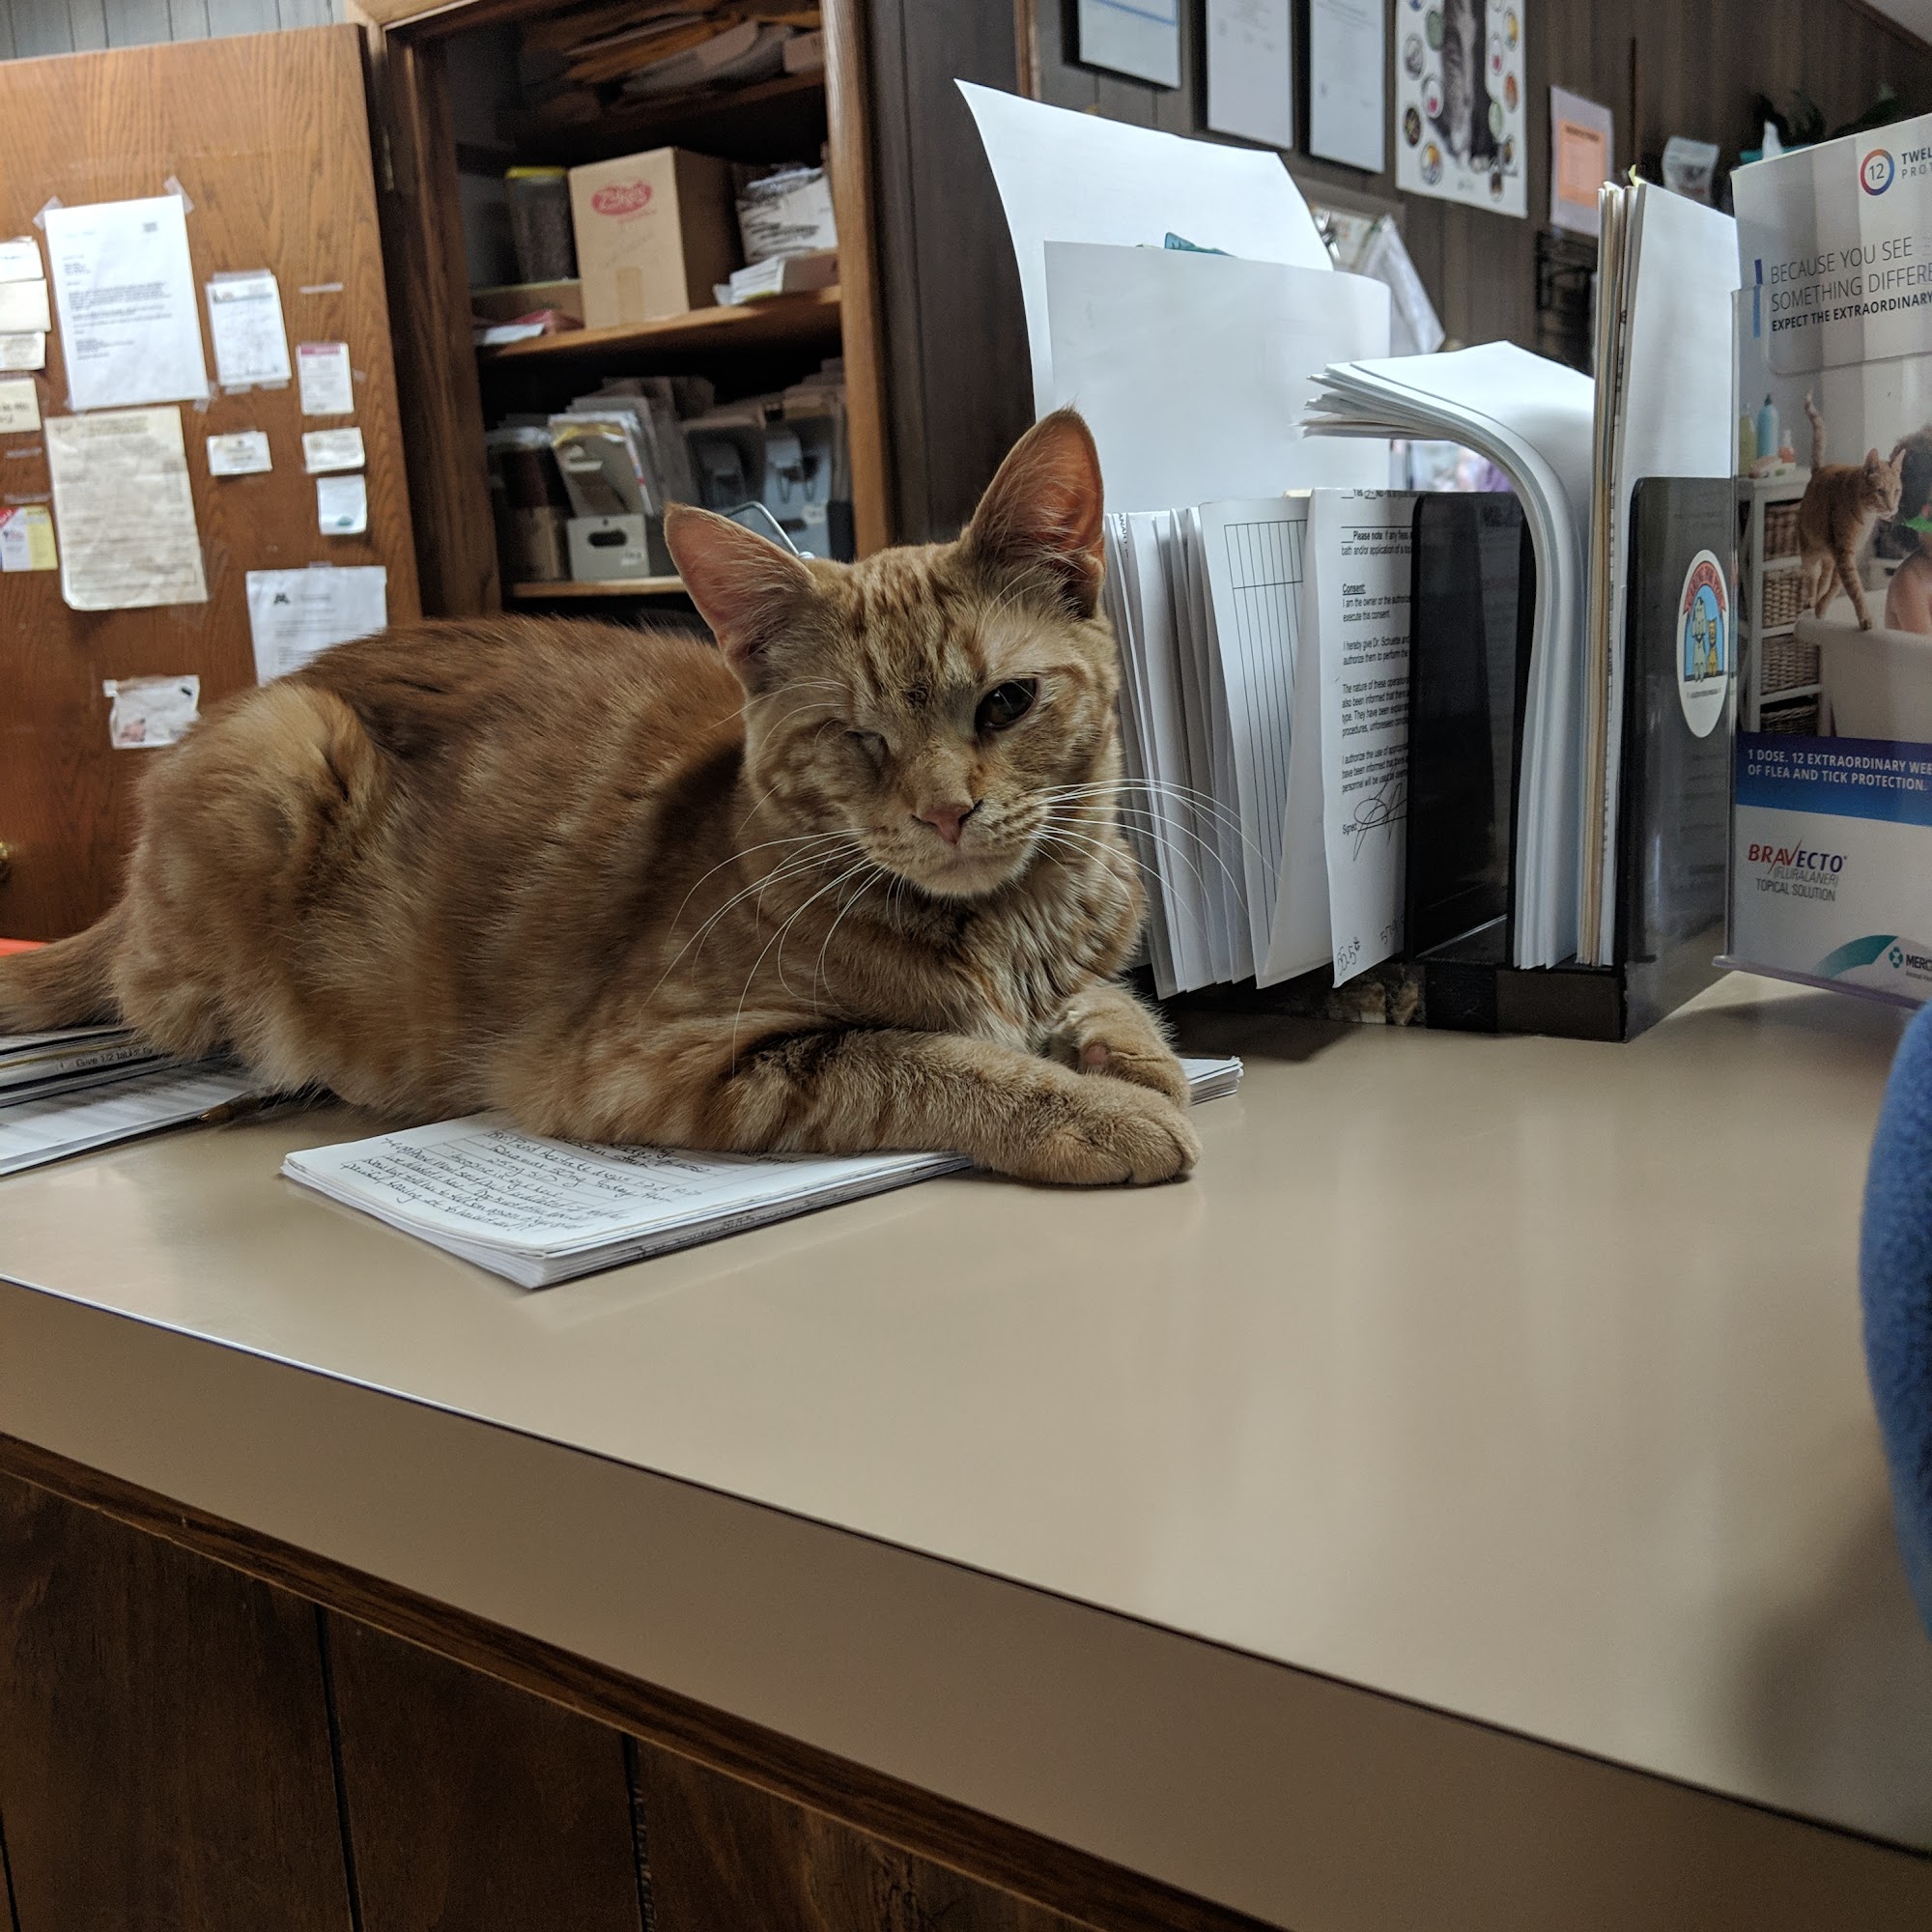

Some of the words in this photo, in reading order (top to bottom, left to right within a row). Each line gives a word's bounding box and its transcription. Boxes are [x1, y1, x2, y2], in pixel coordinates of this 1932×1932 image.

[1868, 163, 1885, 181] 12
[1771, 253, 1835, 285] BECAUSE
[1840, 244, 1876, 268] YOU
[1883, 237, 1913, 260] SEE
[1772, 276, 1862, 312] SOMETHING
[1773, 314, 1808, 332] EXPECT
[1811, 309, 1831, 326] THE
[1353, 530, 1370, 540] Please
[1748, 750, 1754, 760] 1
[1792, 753, 1804, 764] 12
[1807, 753, 1906, 772] EXTRAORDINARY
[1747, 764, 1762, 776] OF
[1765, 765, 1790, 778] FLEA
[1793, 767, 1818, 781] AND
[1822, 769, 1848, 784] TICK
[1756, 878, 1789, 895] TOPICAL
[1792, 883, 1835, 901] SOLUTION
